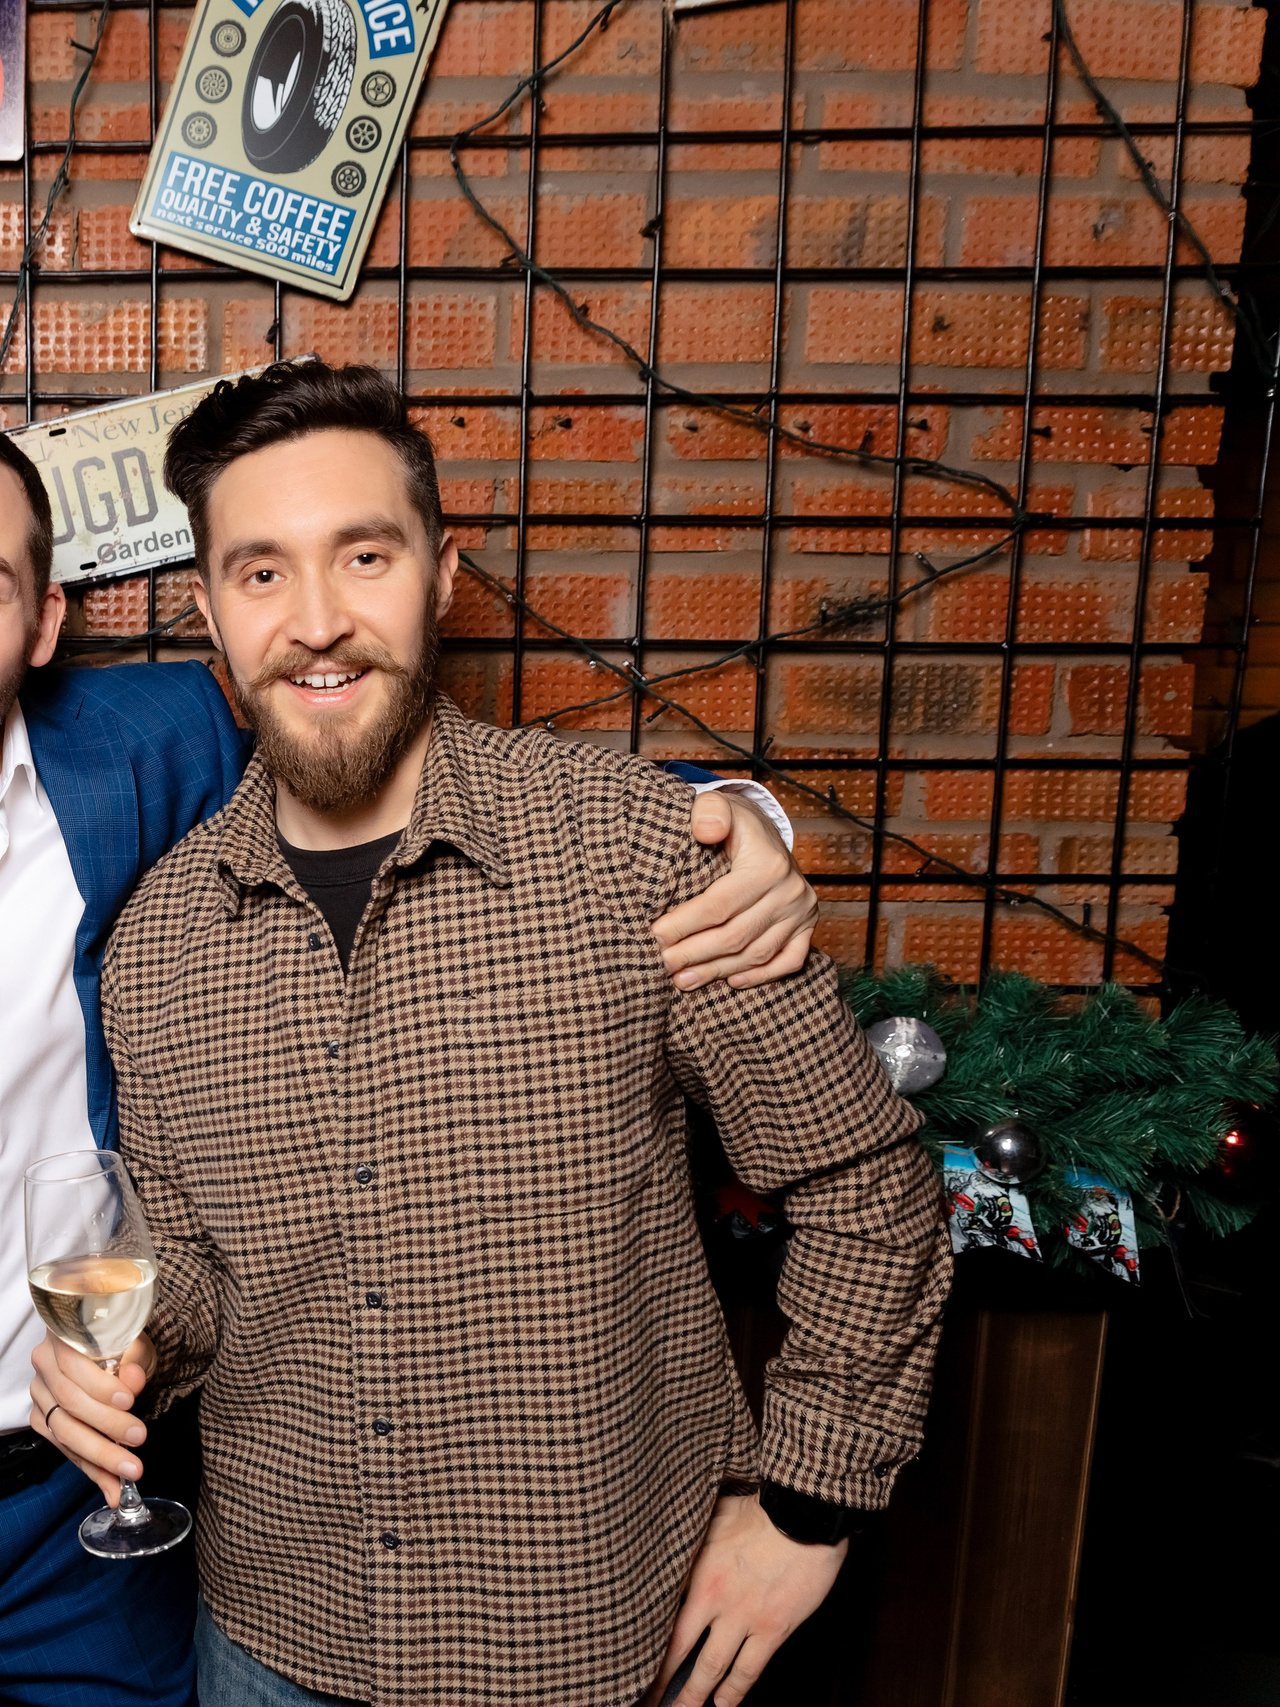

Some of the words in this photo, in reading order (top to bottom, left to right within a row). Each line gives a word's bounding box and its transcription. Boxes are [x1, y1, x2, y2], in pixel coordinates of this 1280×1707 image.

[160, 188, 244, 230] QUALITY
[245, 217, 263, 237] &
[266, 222, 342, 261] SAFETY
[166, 155, 241, 207] FREE
[242, 180, 350, 242] COFFEE
[156, 207, 193, 227] next
[196, 219, 253, 246] service
[255, 238, 289, 258] 500
[291, 250, 334, 273] miles
[72, 416, 141, 448] New
[147, 402, 195, 434] Jer
[97, 527, 191, 564] Garden
